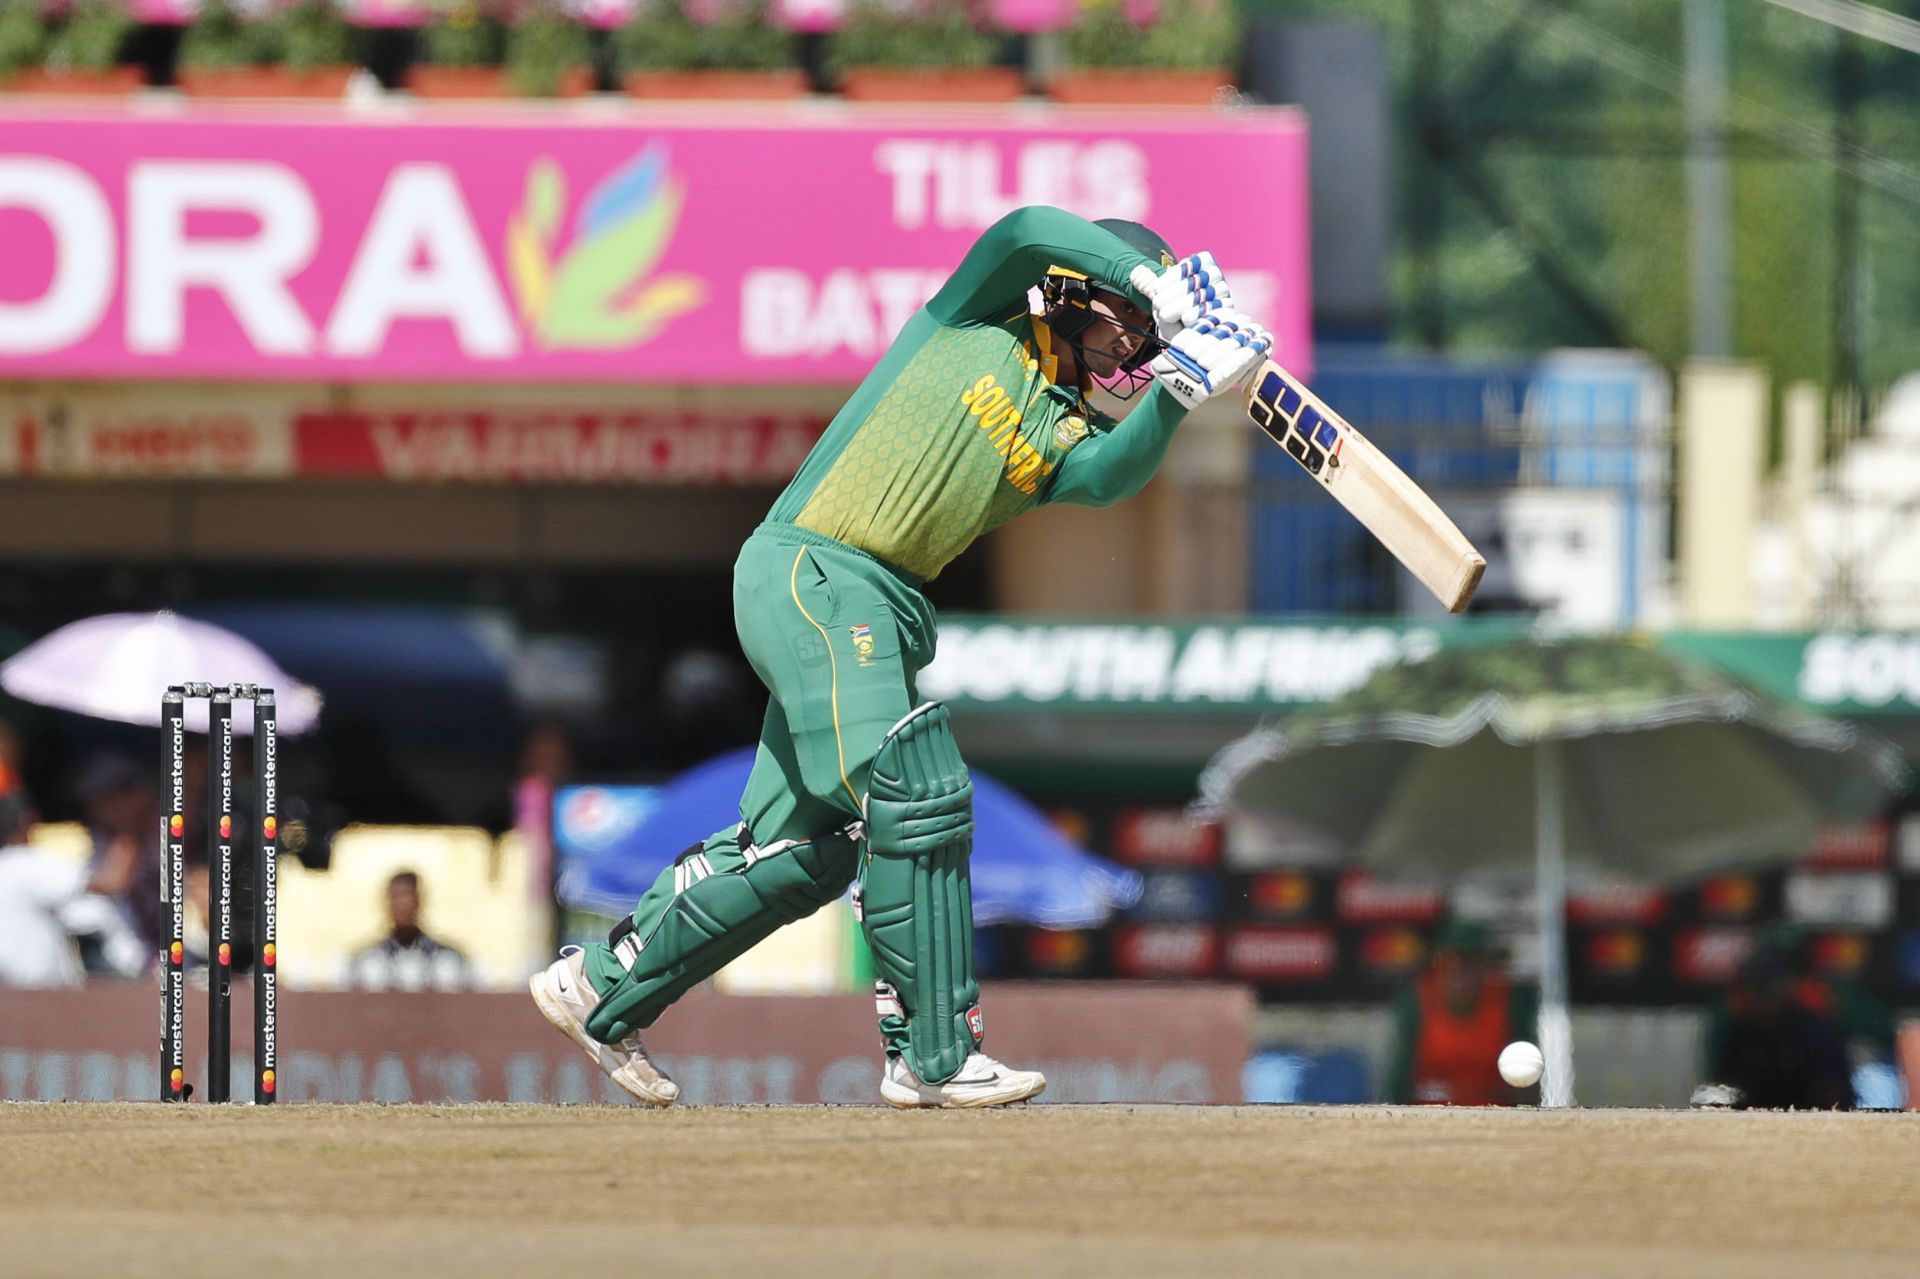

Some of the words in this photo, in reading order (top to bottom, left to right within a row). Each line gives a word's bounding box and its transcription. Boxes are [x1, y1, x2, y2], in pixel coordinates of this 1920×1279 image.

[874, 138, 1152, 229] TILES
[1172, 378, 1195, 398] SS
[171, 717, 183, 812] mastercard
[220, 718, 231, 813] mastercard
[264, 720, 276, 814] mastercard
[170, 844, 183, 939] mastercard
[219, 845, 231, 940] mastercard
[264, 846, 276, 941] mastercard
[171, 971, 183, 1066] mastercard
[263, 973, 275, 1068] mastercard
